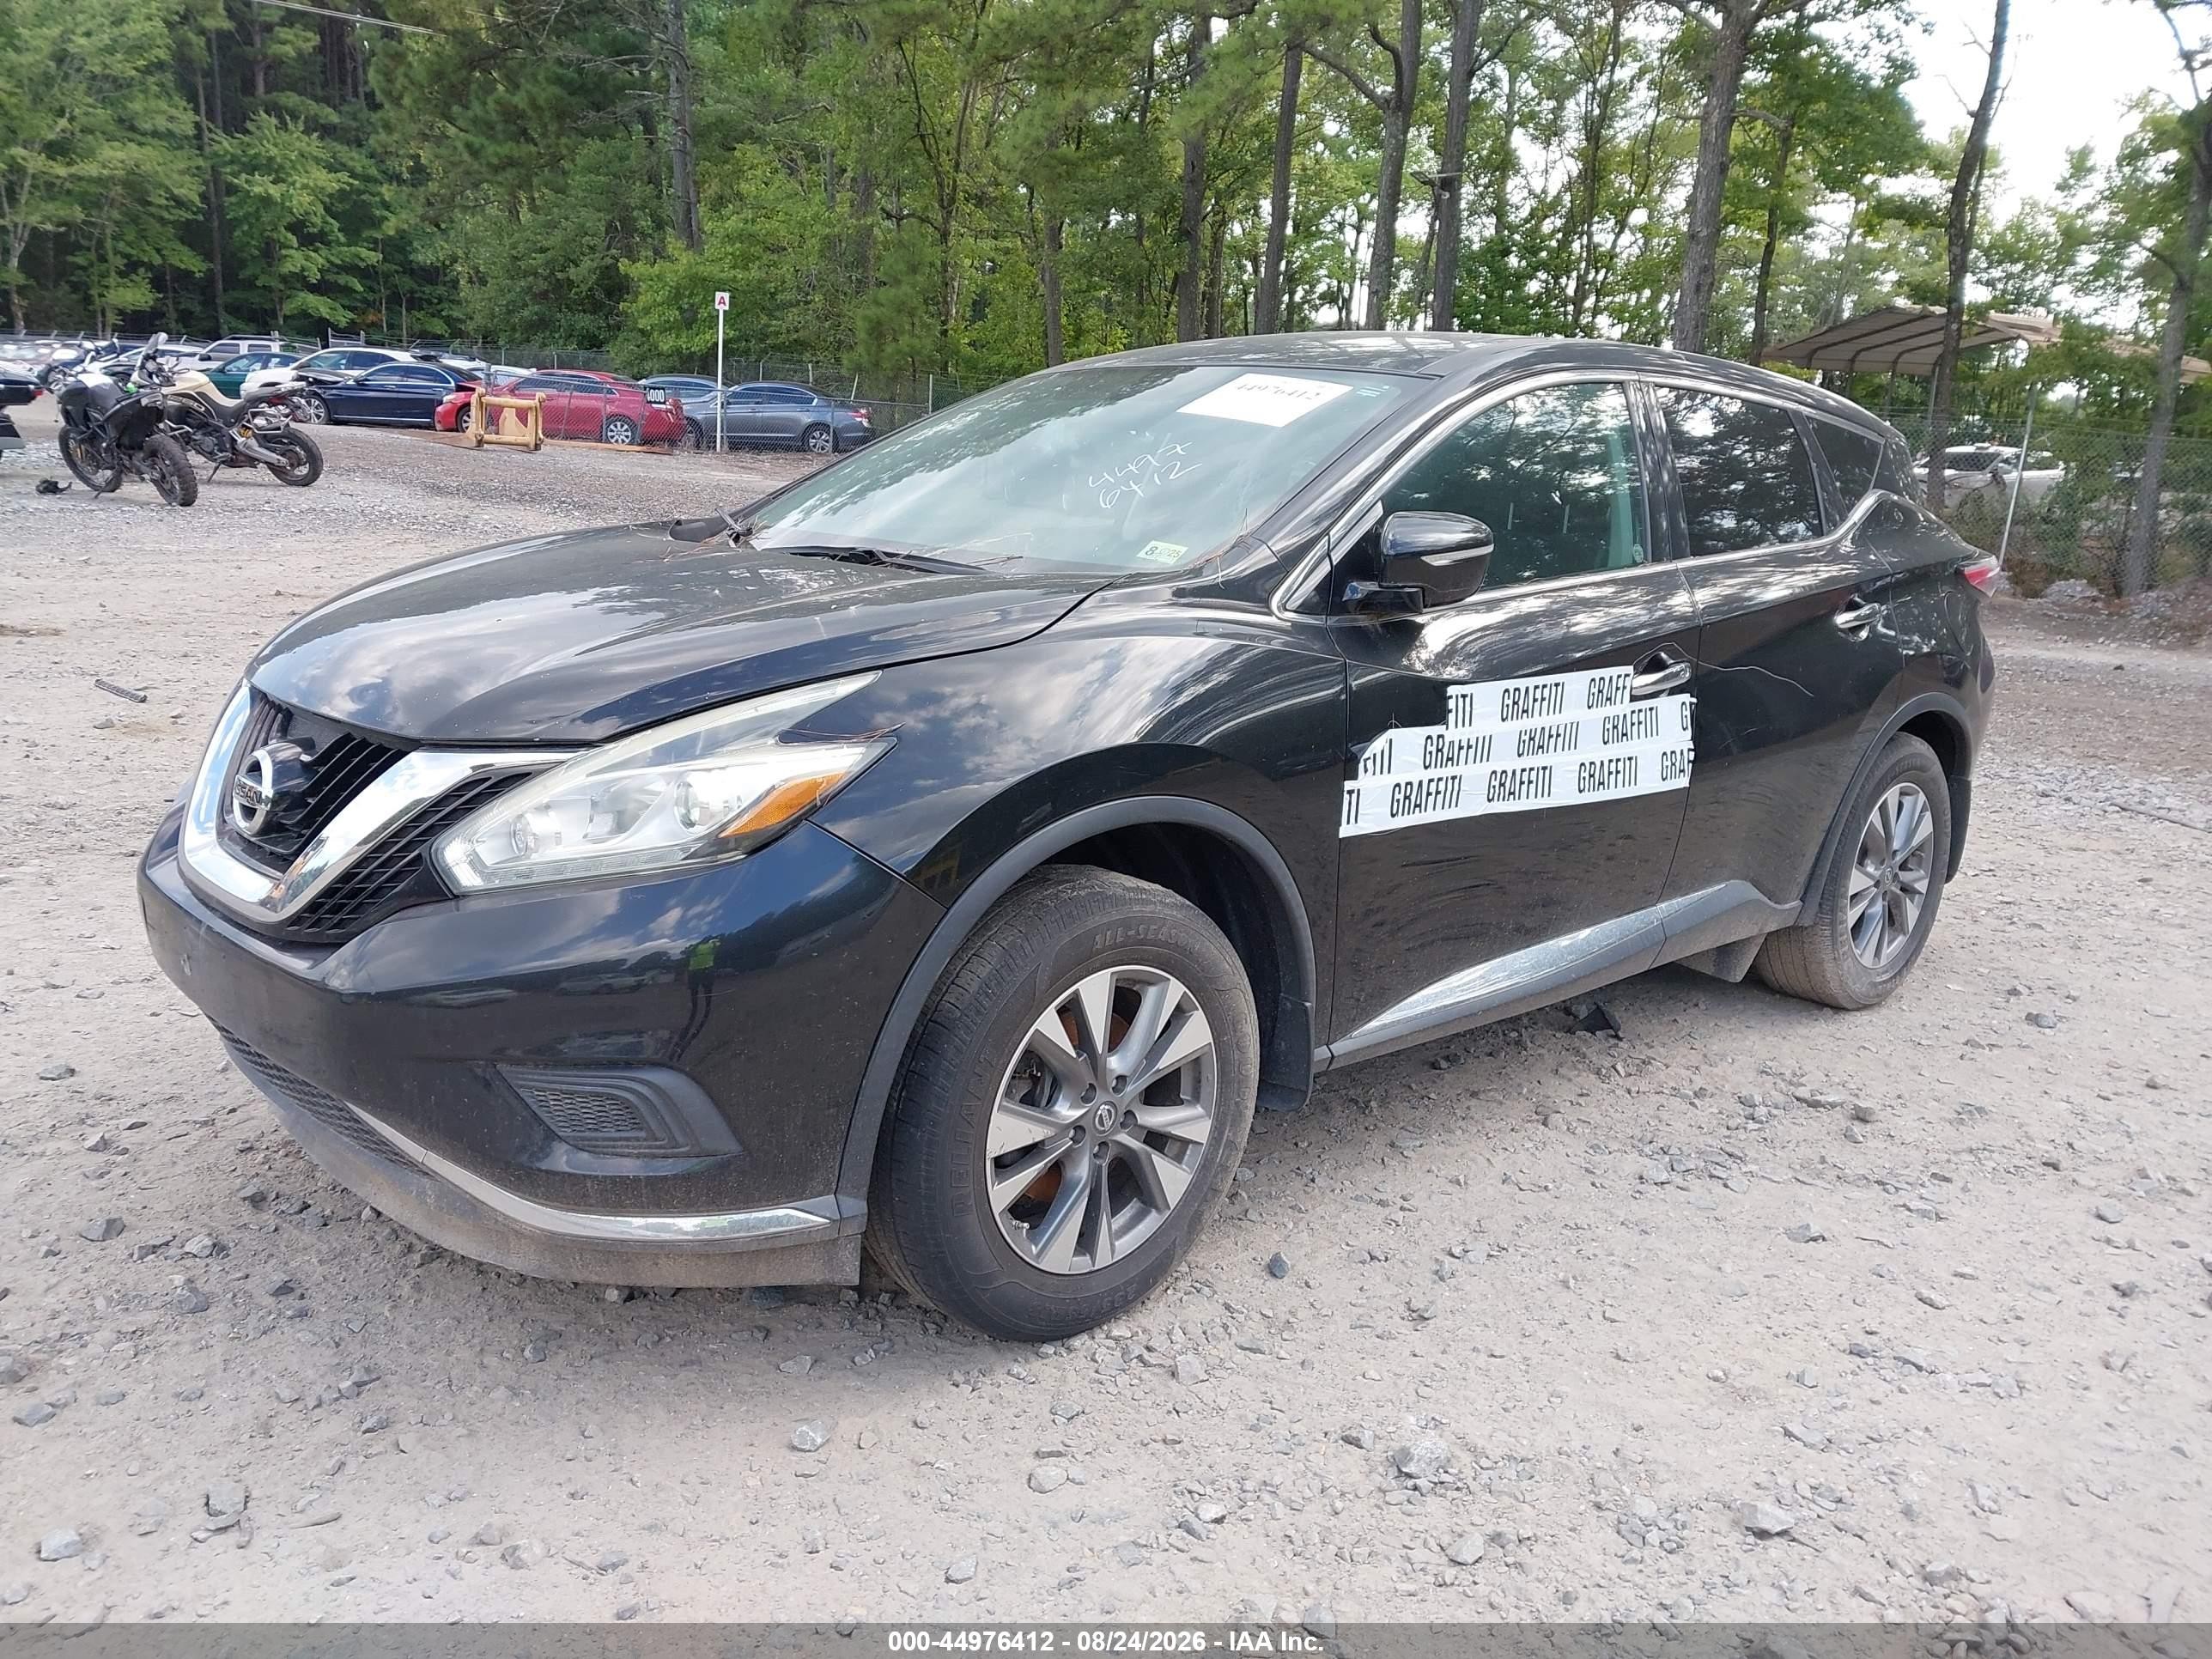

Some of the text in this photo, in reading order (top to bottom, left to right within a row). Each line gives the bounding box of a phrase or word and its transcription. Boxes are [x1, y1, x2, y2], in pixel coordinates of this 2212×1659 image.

[717, 295, 726, 307] A
[1099, 460, 1203, 508] 6412
[1500, 681, 1565, 723] GRAFFITI
[1516, 720, 1580, 758] GRAFFITI
[1601, 705, 1659, 746] GRAFFITI
[1390, 774, 1463, 819] GRAFFITI
[1486, 764, 1553, 804] GRAFFITI
[1577, 755, 1638, 795] GRAFFITI
